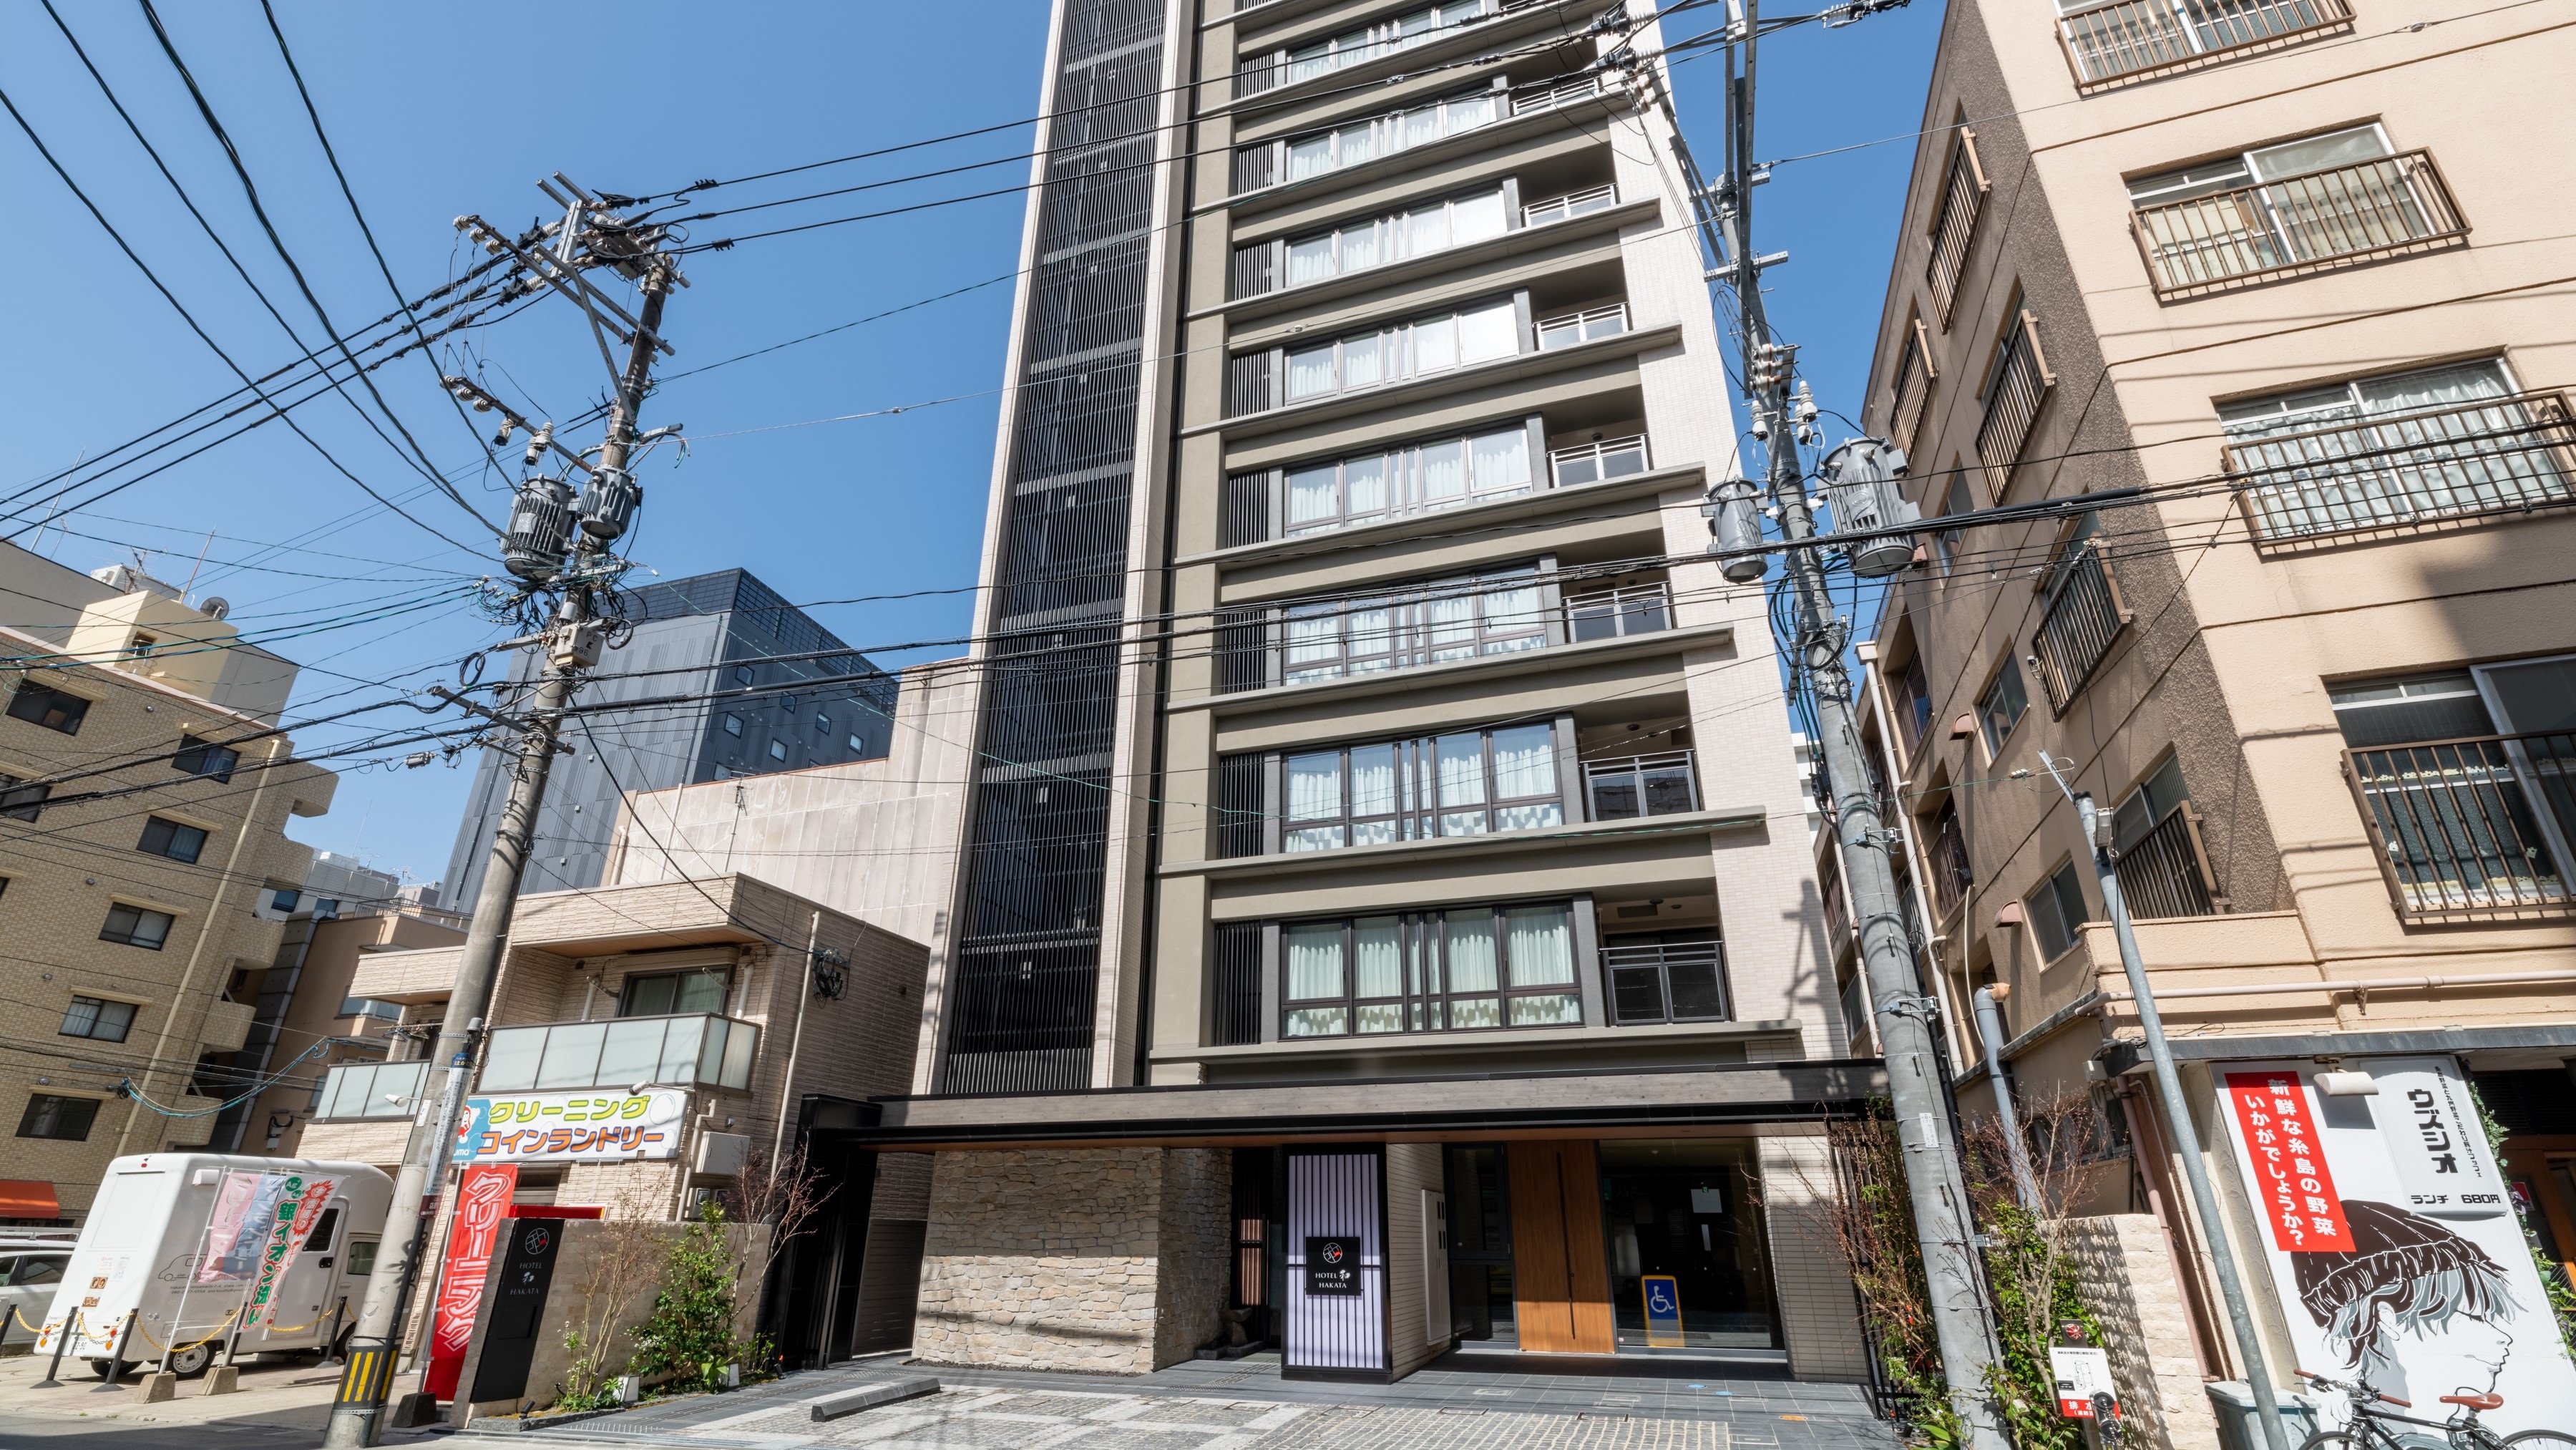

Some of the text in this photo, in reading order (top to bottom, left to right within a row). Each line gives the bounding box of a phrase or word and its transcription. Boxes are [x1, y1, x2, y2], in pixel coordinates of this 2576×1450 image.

[477, 1126, 664, 1155] コインランドリー
[488, 1095, 652, 1124] クリーニング
[2407, 1089, 2459, 1174] ウズシオ
[2244, 1094, 2304, 1246] いかがでしょうか?
[2268, 1079, 2337, 1237] 新鮮な糸島の野菜
[2411, 1194, 2501, 1205] ランチ 680円
[245, 1201, 299, 1328] 銀イオン洗い
